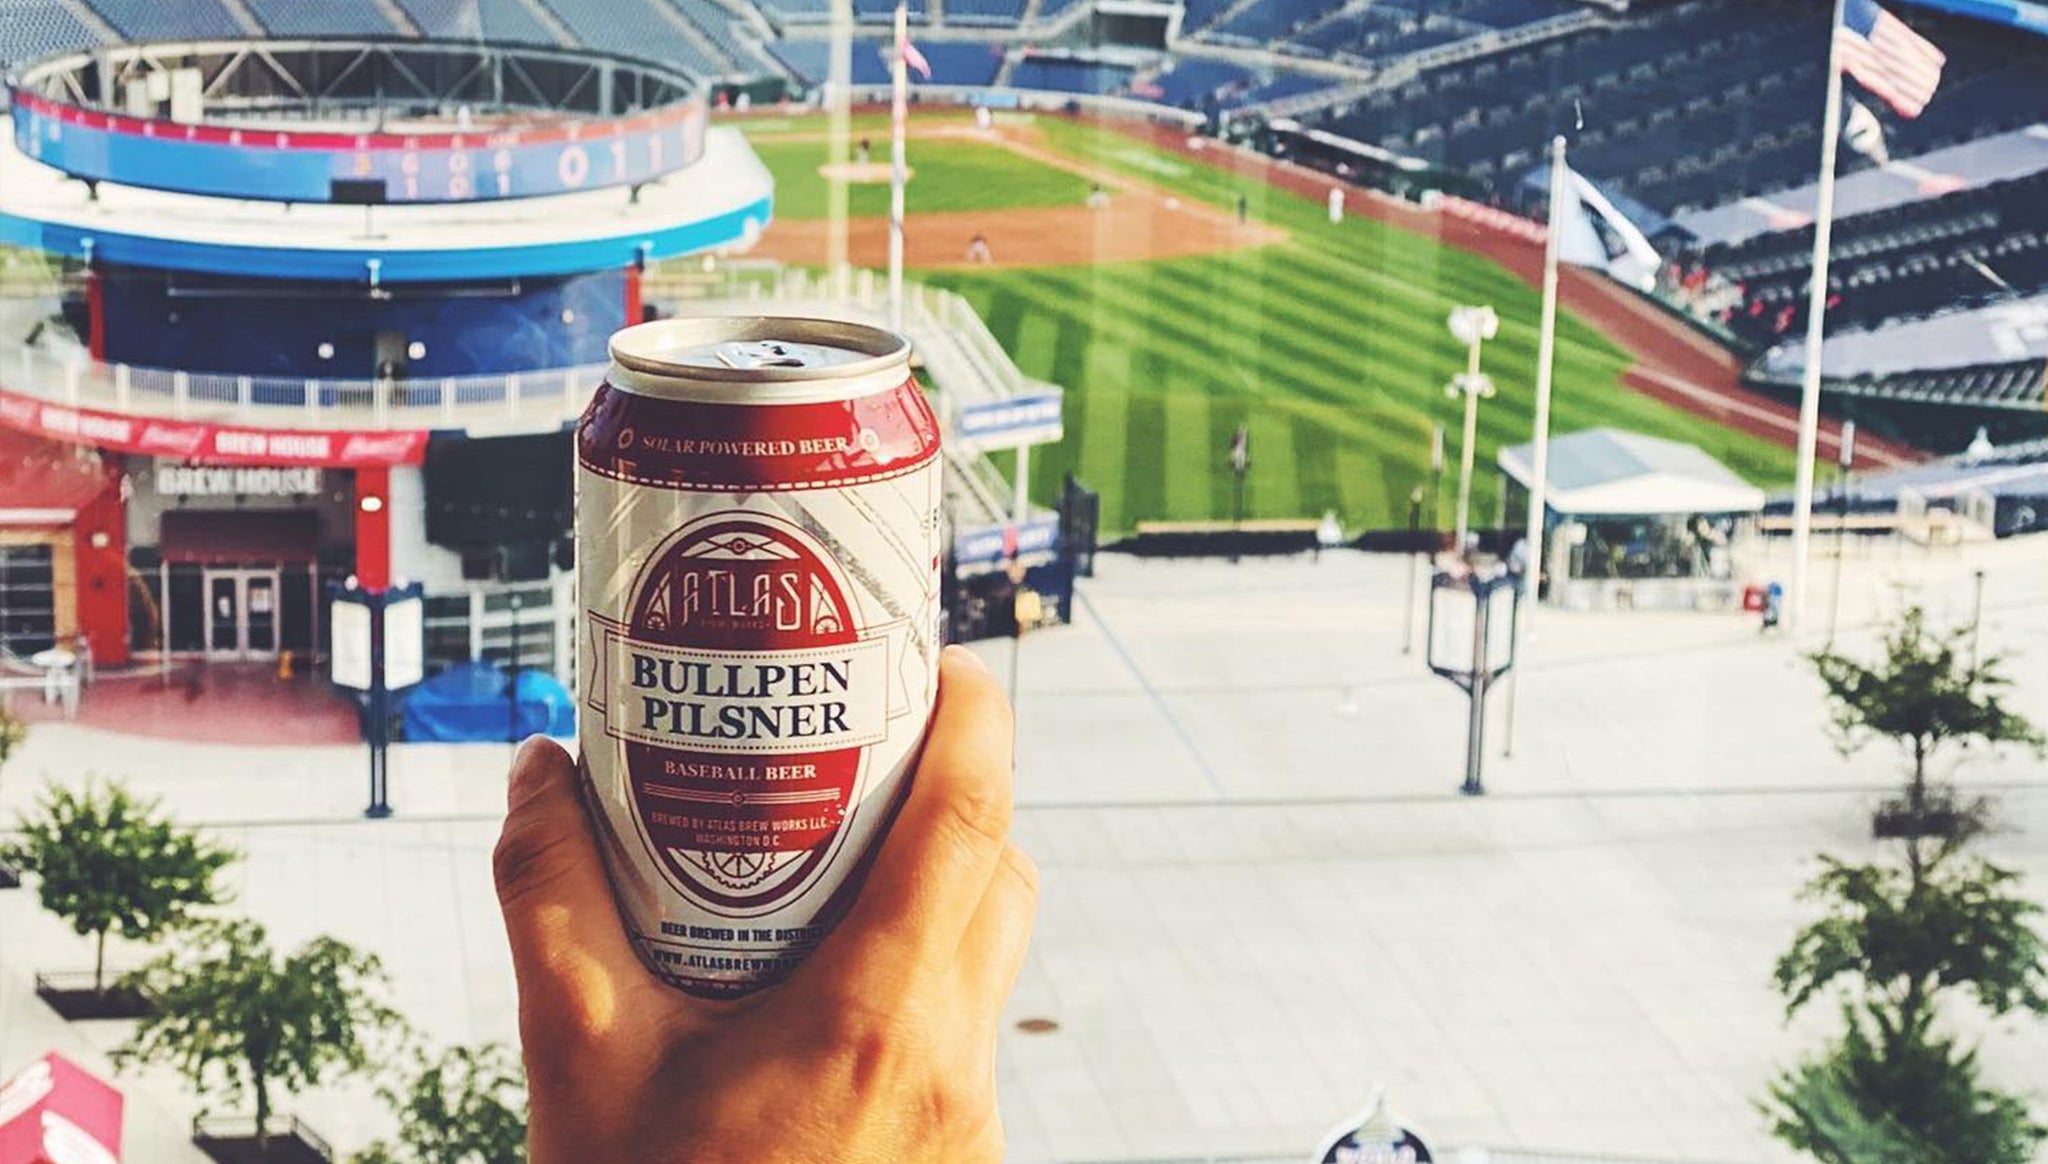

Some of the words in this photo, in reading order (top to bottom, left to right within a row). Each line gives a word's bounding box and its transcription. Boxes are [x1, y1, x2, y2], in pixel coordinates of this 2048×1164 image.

[558, 144, 590, 190] 0
[611, 139, 626, 180] 1
[215, 431, 267, 455] BREW
[269, 435, 330, 459] HOUSE
[643, 436, 694, 454] SOLAR
[700, 440, 796, 456] POWERED
[800, 436, 849, 455] BEER
[157, 467, 233, 495] BREW
[235, 467, 321, 495] HOUSE
[682, 570, 801, 631] ATLAS
[631, 653, 853, 698] BULLPEN
[642, 696, 851, 740] PILSNER
[664, 760, 761, 780] BASEBALL
[765, 764, 817, 780] BEER
[652, 811, 689, 829] BREWED
[692, 818, 705, 829] BY
[707, 818, 736, 832] ATLAS
[739, 818, 769, 832] BREW
[771, 817, 808, 831] WORKS
[695, 832, 760, 847] WASHINGTON
[661, 921, 687, 937] BEER
[689, 926, 734, 941] BREWED
[737, 929, 749, 941] IN
[751, 929, 772, 942] THE
